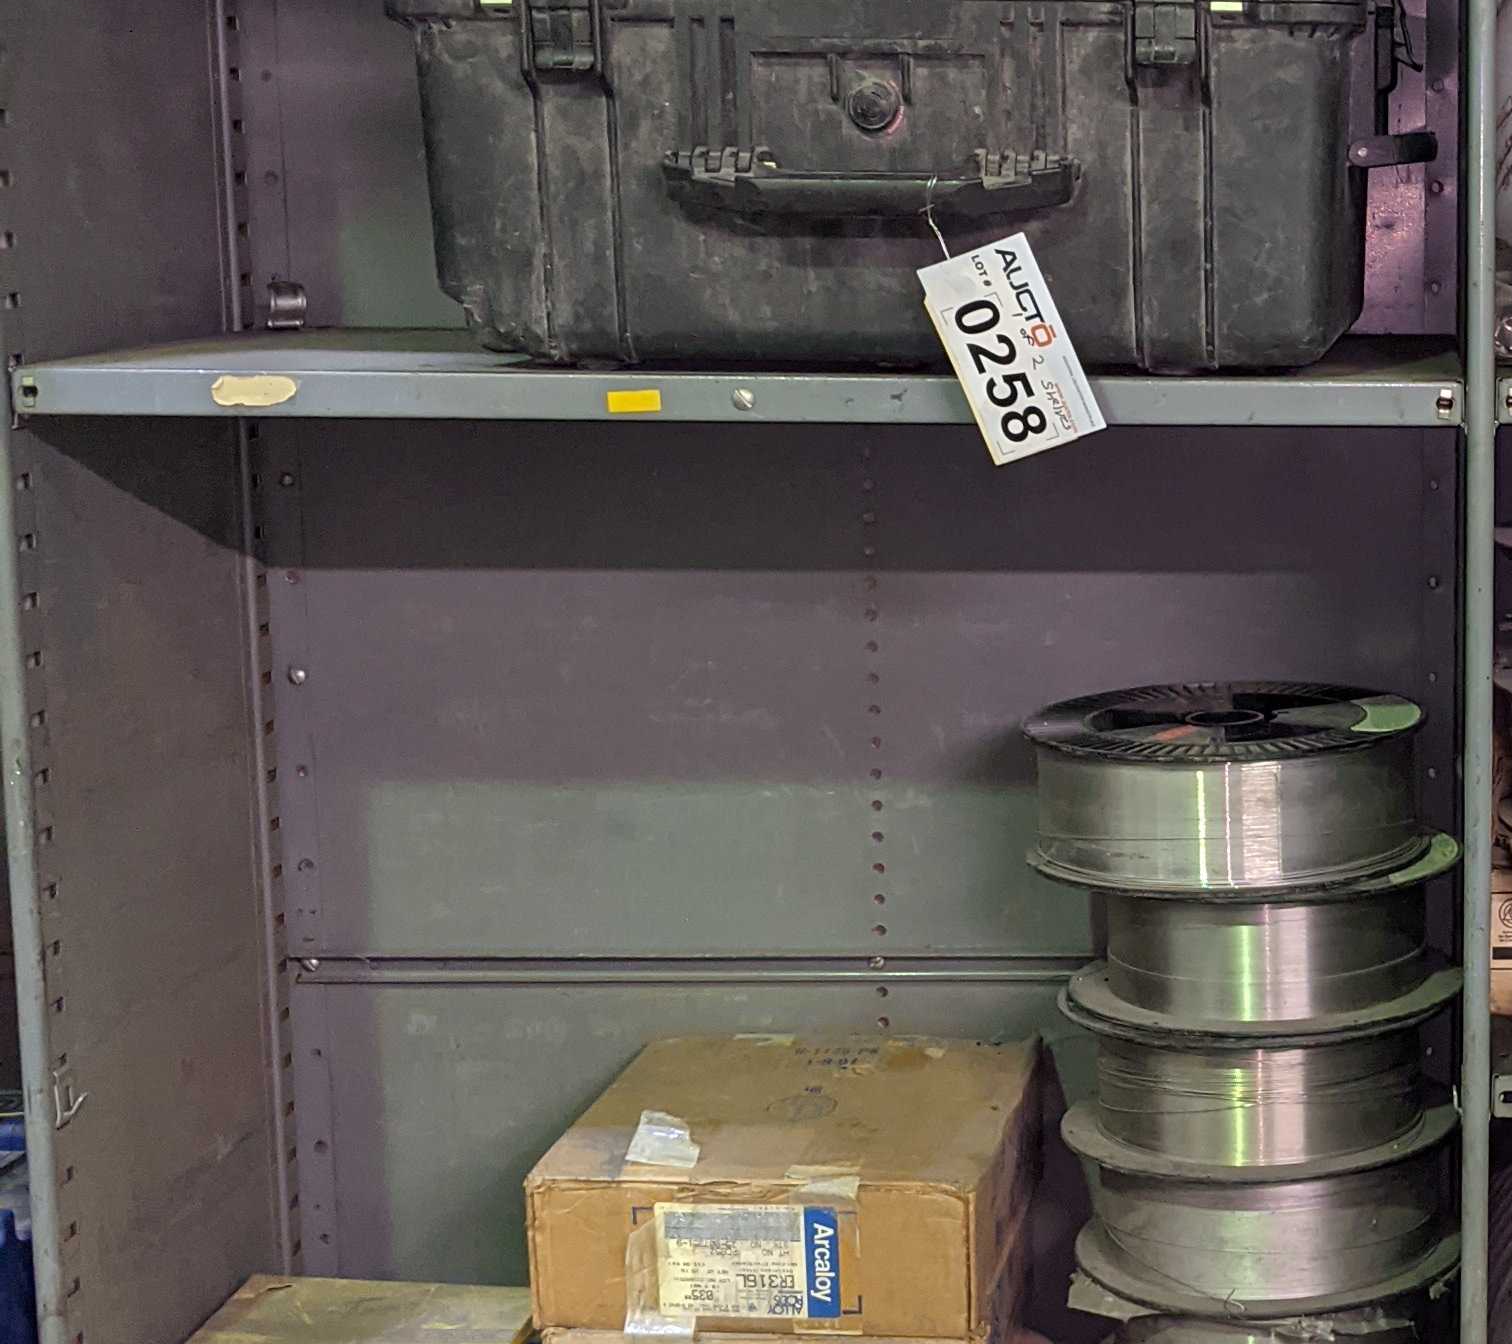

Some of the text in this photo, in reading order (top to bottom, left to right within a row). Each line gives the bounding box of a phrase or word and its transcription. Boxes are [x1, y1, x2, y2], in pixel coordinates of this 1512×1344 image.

[970, 254, 988, 279] LOT
[954, 298, 1048, 443] 0258
[1031, 355, 1045, 370] 2
[810, 1222, 837, 1303] Arcaloy
[735, 1274, 795, 1289] ER316L
